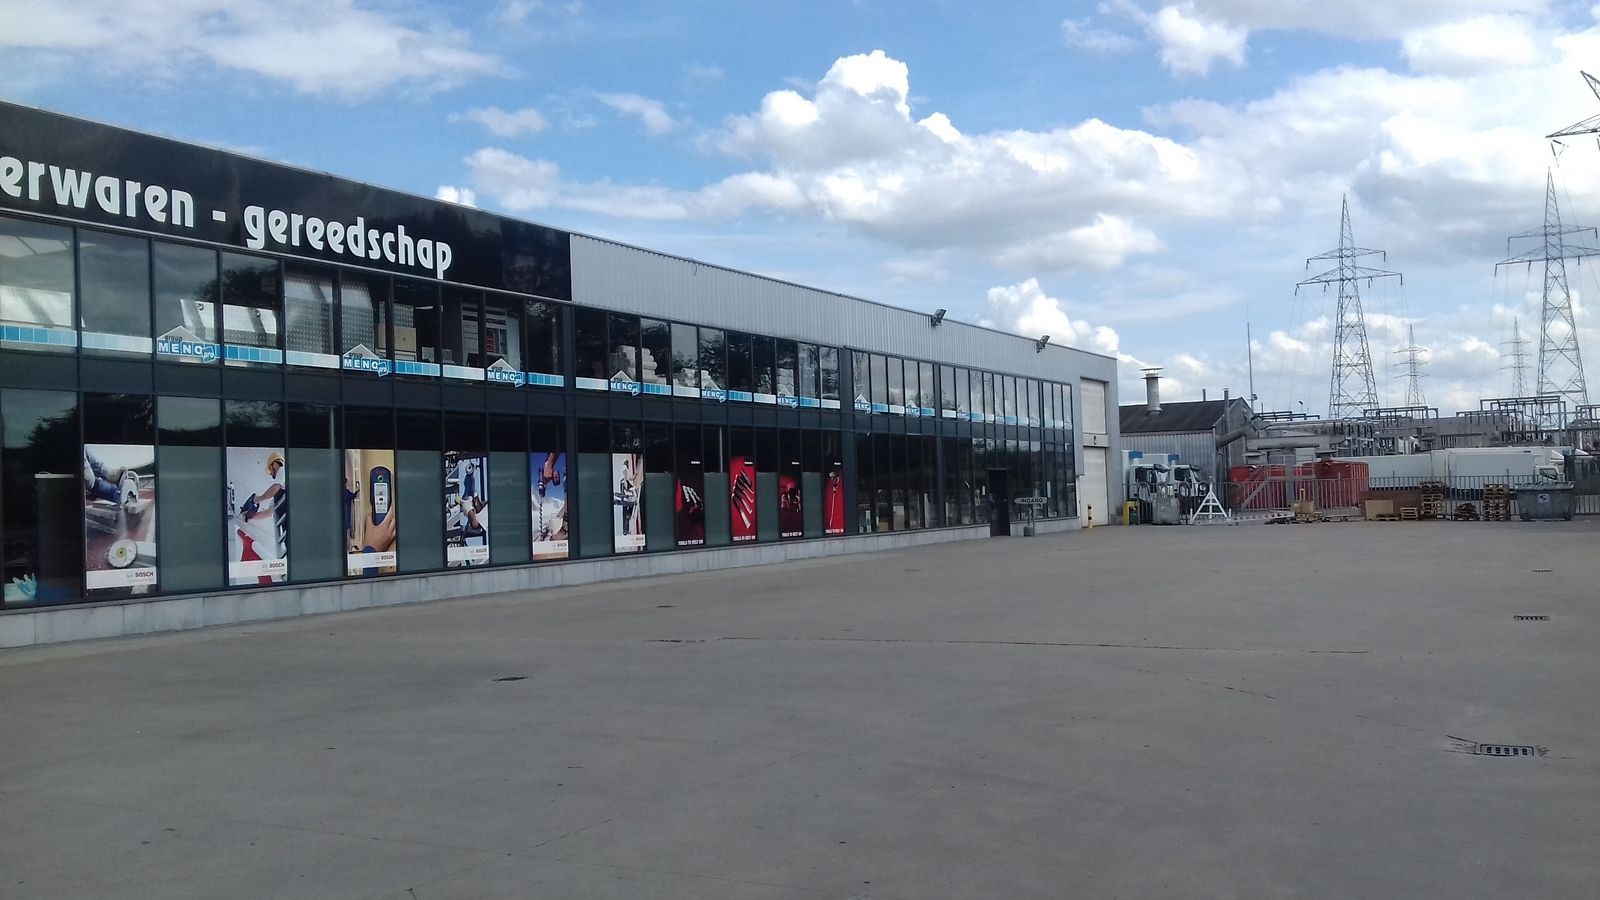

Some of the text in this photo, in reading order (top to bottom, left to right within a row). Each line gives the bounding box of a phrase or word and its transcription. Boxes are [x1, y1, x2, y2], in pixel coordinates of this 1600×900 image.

[0, 156, 194, 228] erwaren
[243, 205, 452, 279] gereedschap
[158, 342, 202, 354] MENO
[344, 358, 378, 370] MENO
[487, 371, 515, 381] MENO
